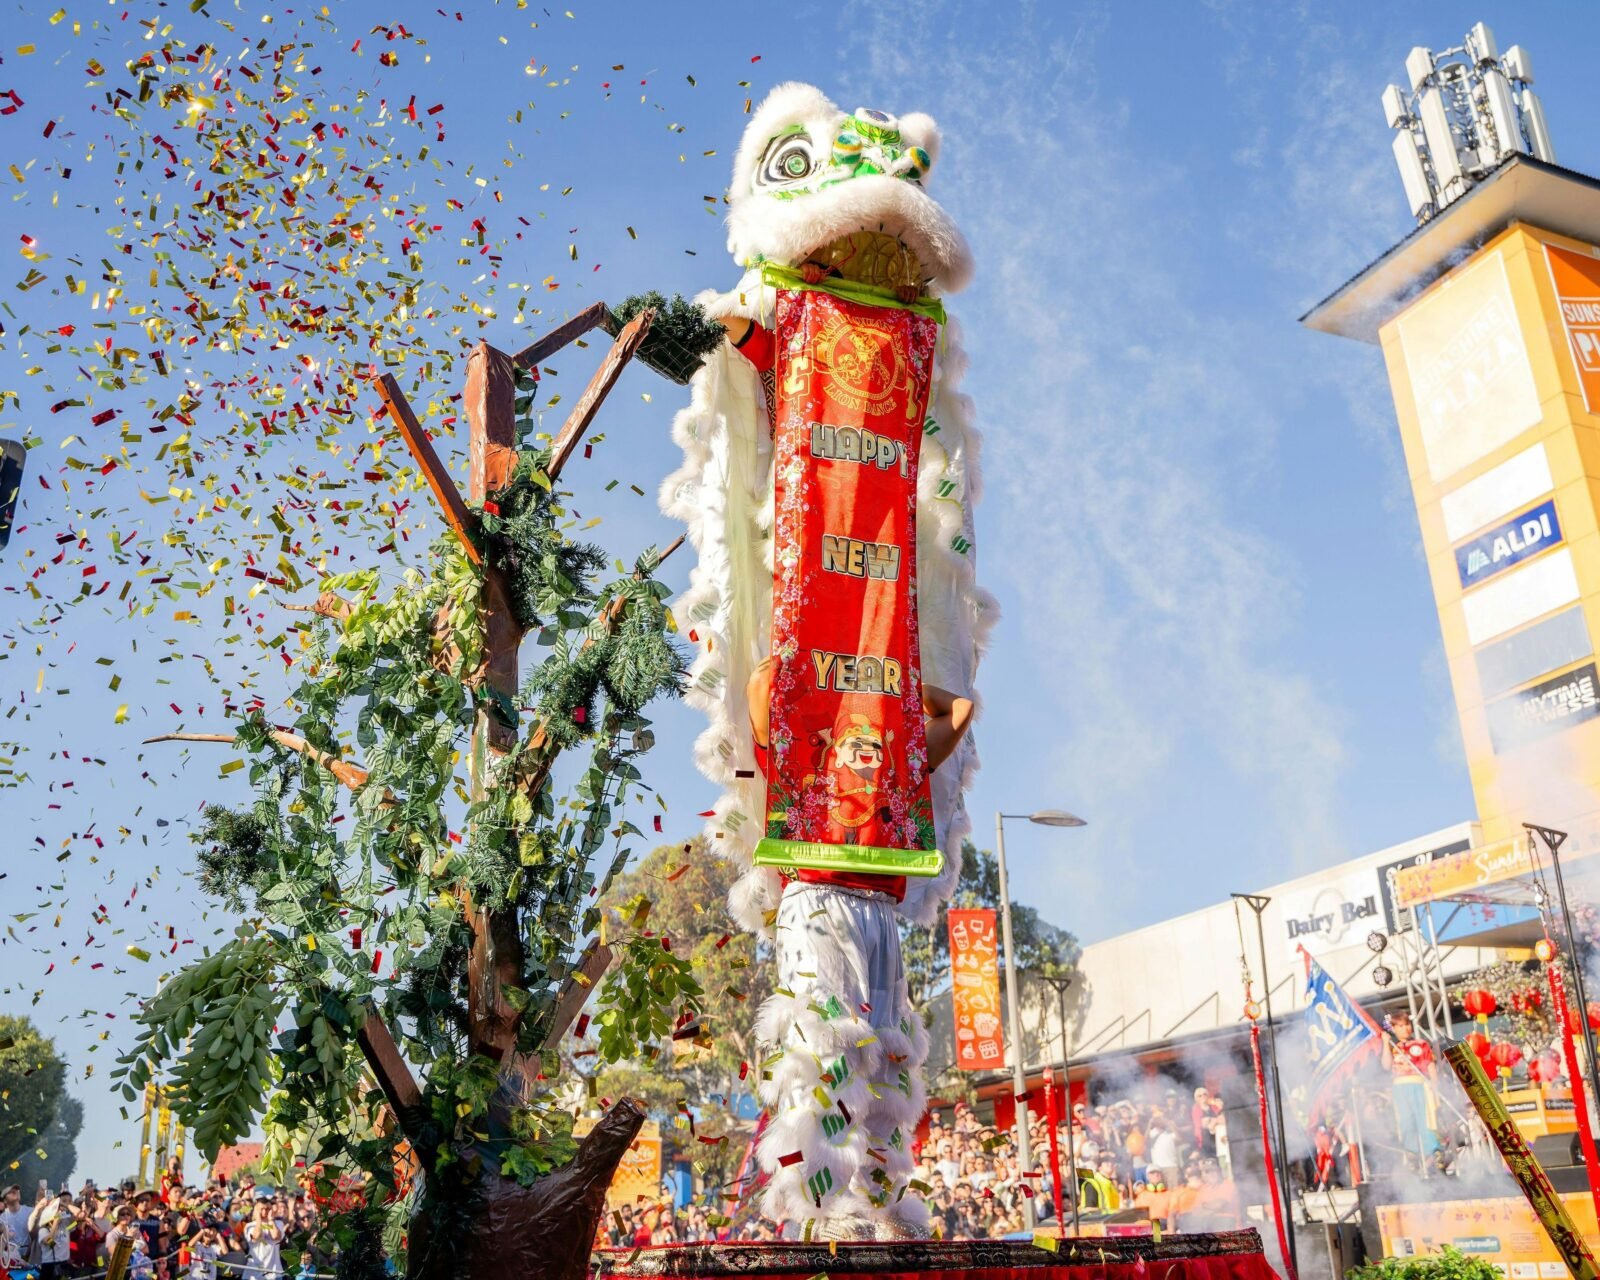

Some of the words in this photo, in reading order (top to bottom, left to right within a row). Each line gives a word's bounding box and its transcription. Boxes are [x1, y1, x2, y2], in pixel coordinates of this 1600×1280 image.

[823, 382, 861, 411] LION
[863, 396, 898, 417] DANCE
[811, 422, 909, 478] HAPPY
[821, 533, 901, 582] NEW
[1491, 512, 1553, 564] ALDI
[811, 649, 902, 698] YEAR
[1512, 676, 1593, 721] ANYTIME
[1286, 912, 1335, 940] Dairy
[1341, 895, 1379, 925] Bell
